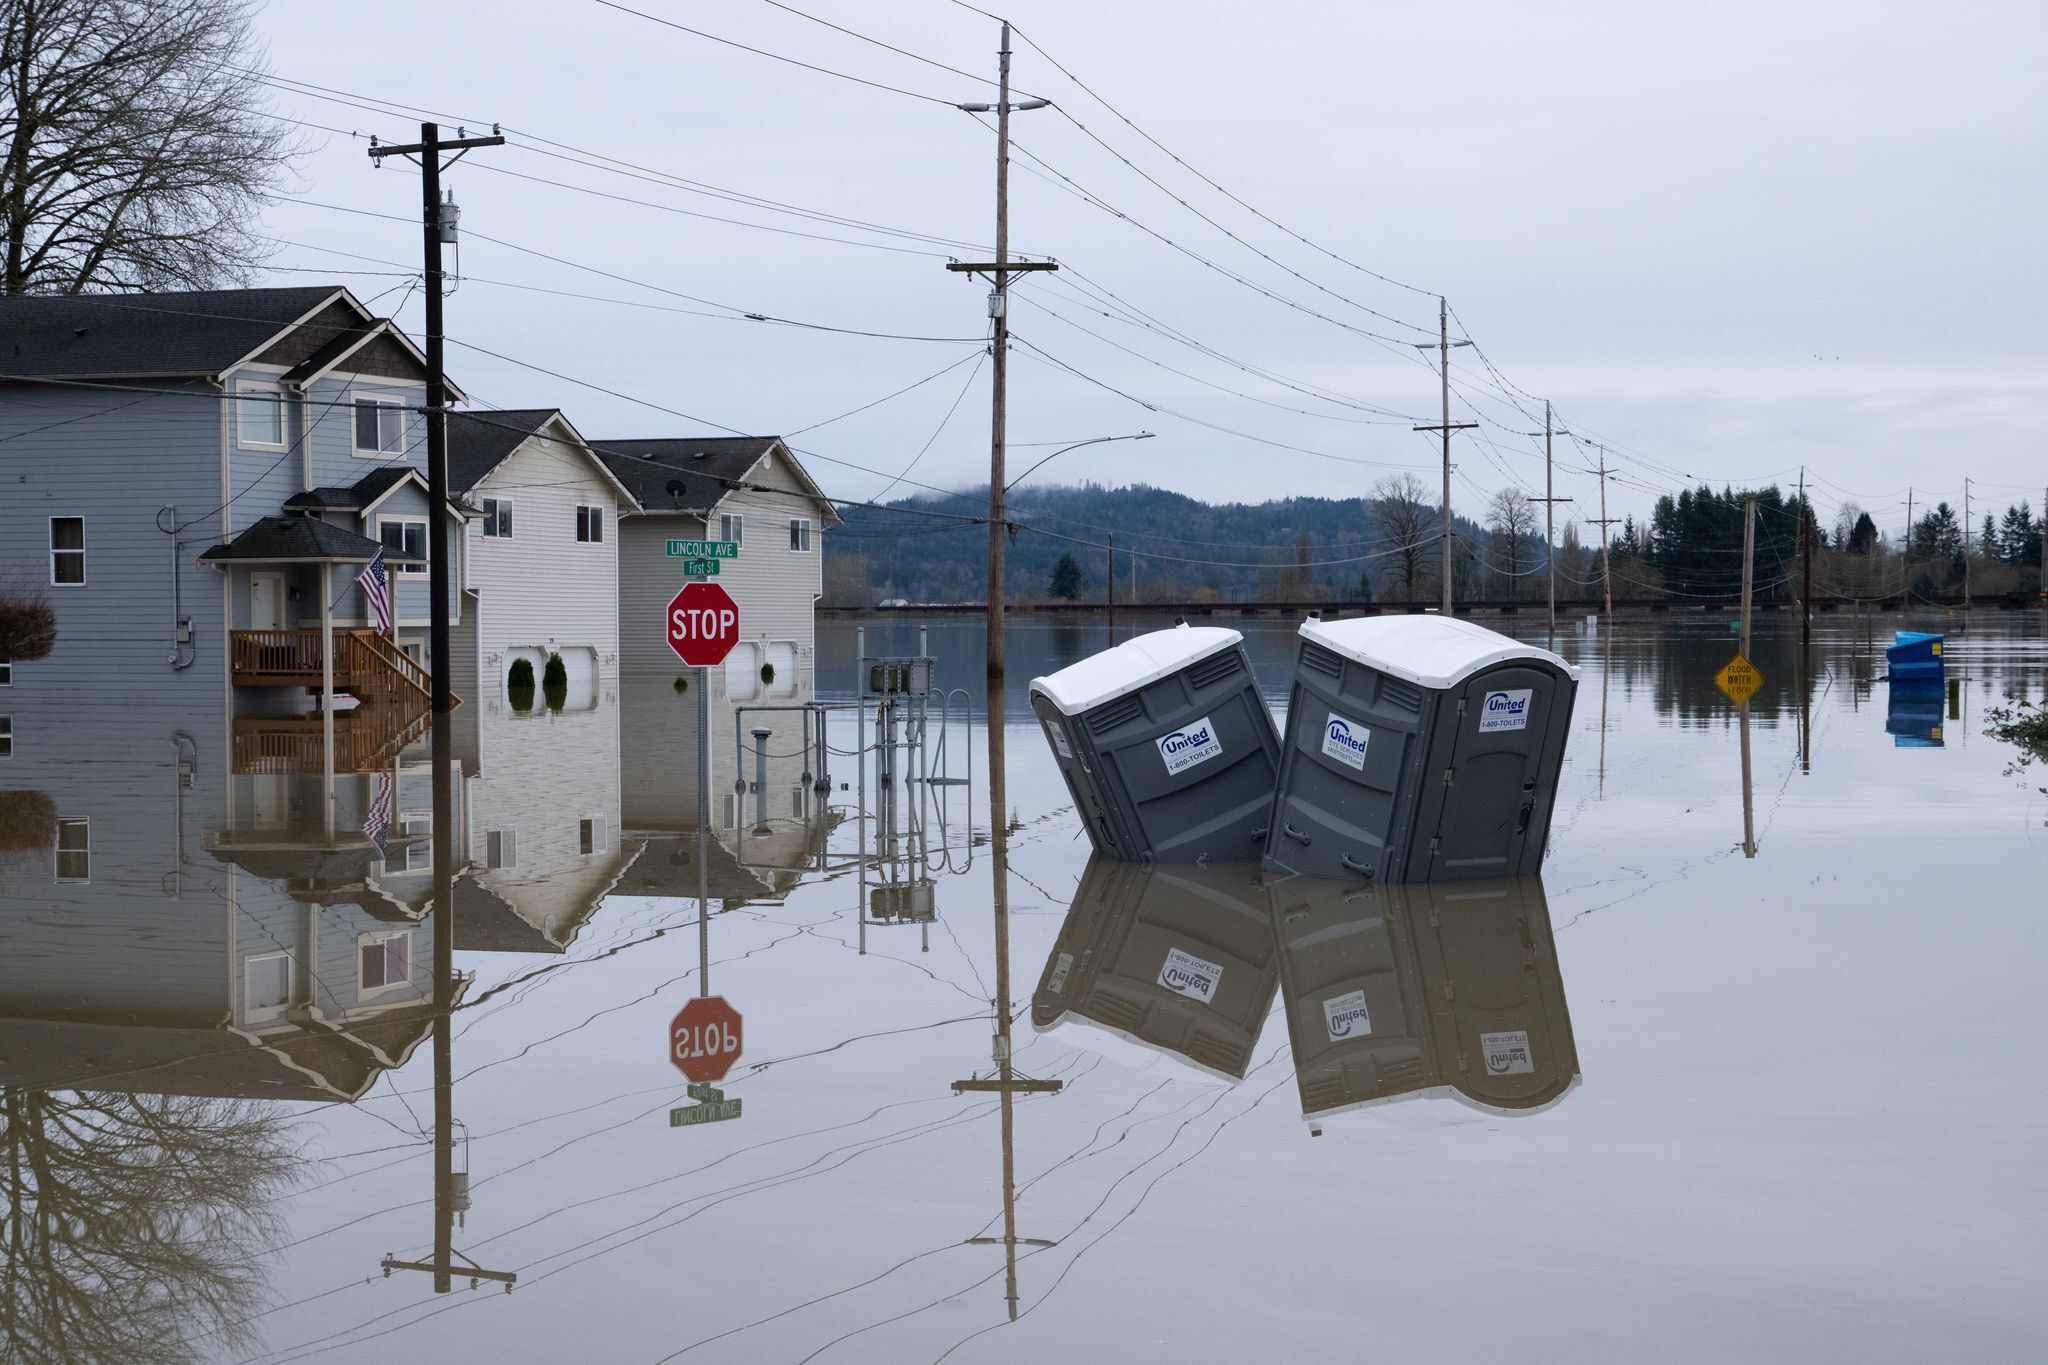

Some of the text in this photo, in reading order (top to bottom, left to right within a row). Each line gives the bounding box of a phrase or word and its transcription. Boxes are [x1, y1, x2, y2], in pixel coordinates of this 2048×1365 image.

[671, 542, 733, 557] LINCOLN AVE
[689, 561, 714, 574] First St
[672, 608, 735, 640] STOP
[1728, 665, 1751, 673] FLOOD
[1489, 697, 1526, 711] United
[1482, 719, 1525, 728] 1-800-TOILETS
[1166, 727, 1209, 754] United
[1330, 726, 1367, 753] United
[1169, 744, 1219, 771] 1-800-TOILETS
